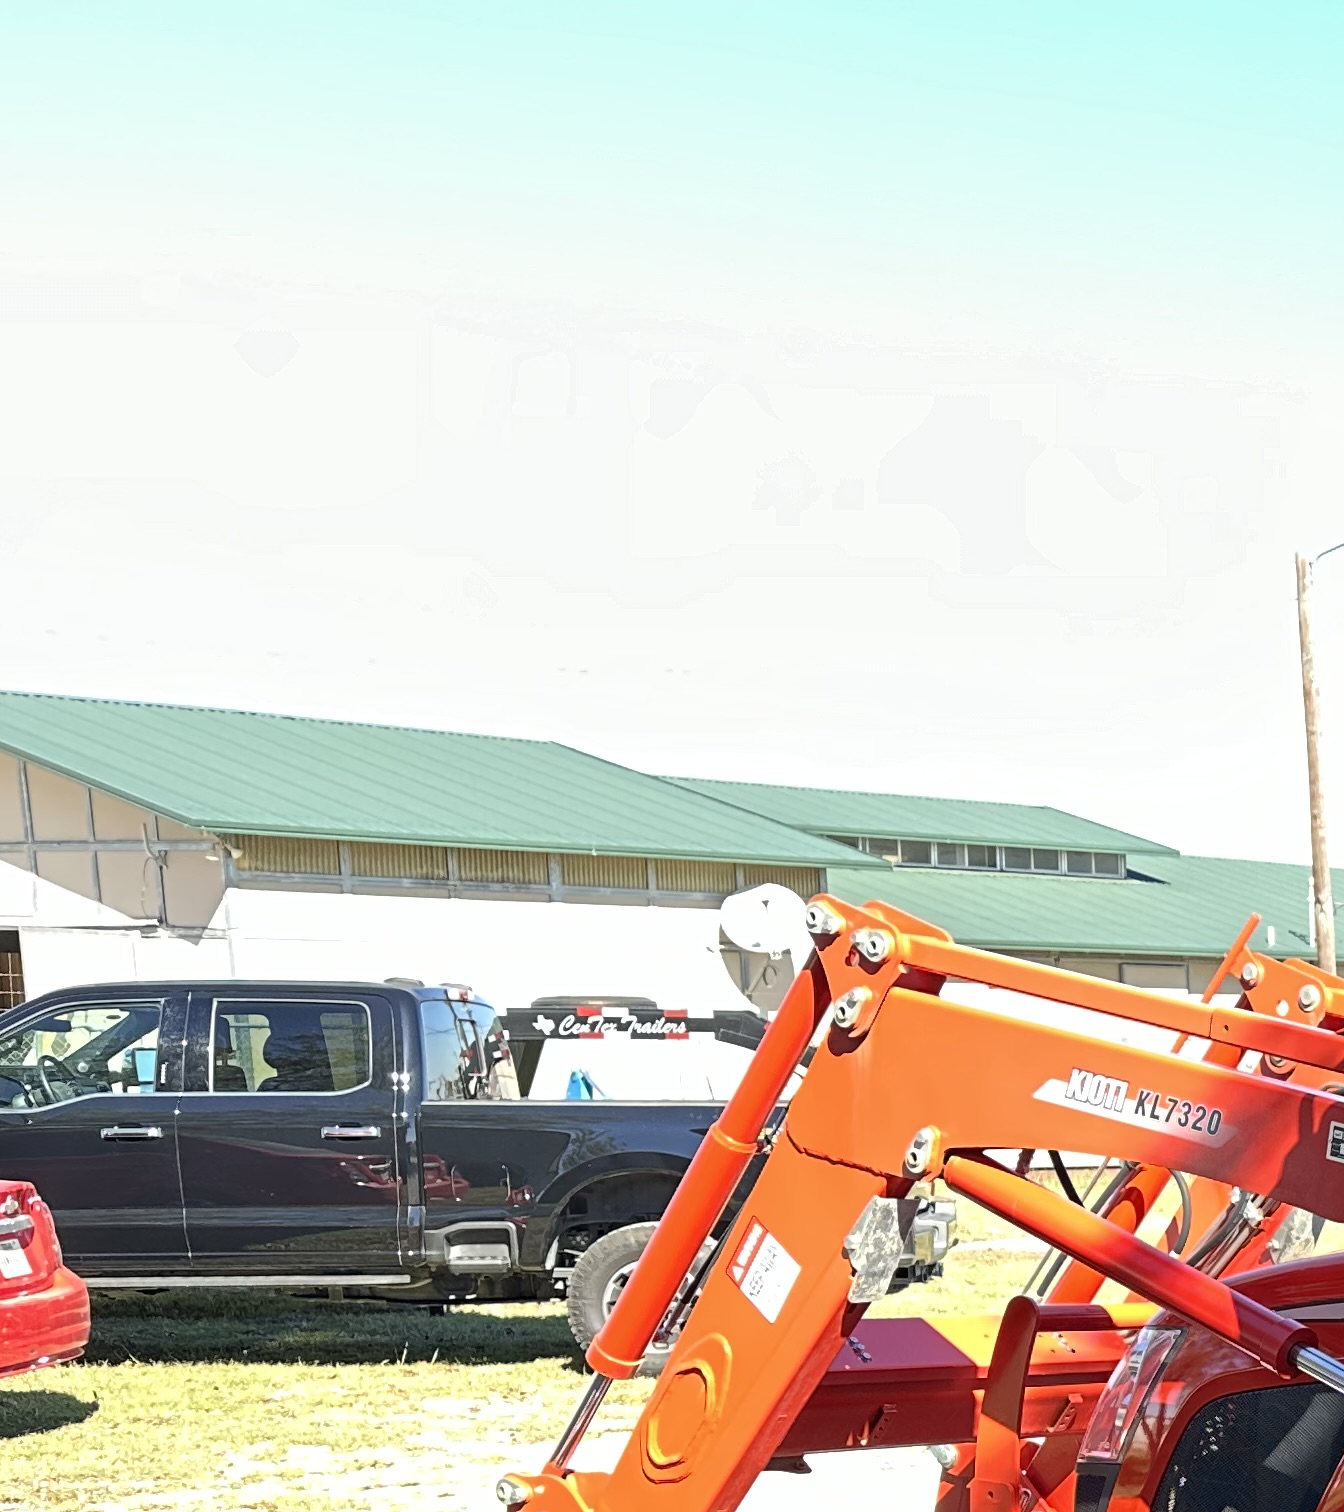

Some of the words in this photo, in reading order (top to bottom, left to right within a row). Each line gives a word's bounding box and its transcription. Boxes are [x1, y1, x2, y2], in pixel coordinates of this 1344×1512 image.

[621, 1014, 687, 1035] Trailers
[1065, 1067, 1129, 1113] KIOTI
[1134, 1090, 1223, 1136] KL7320
